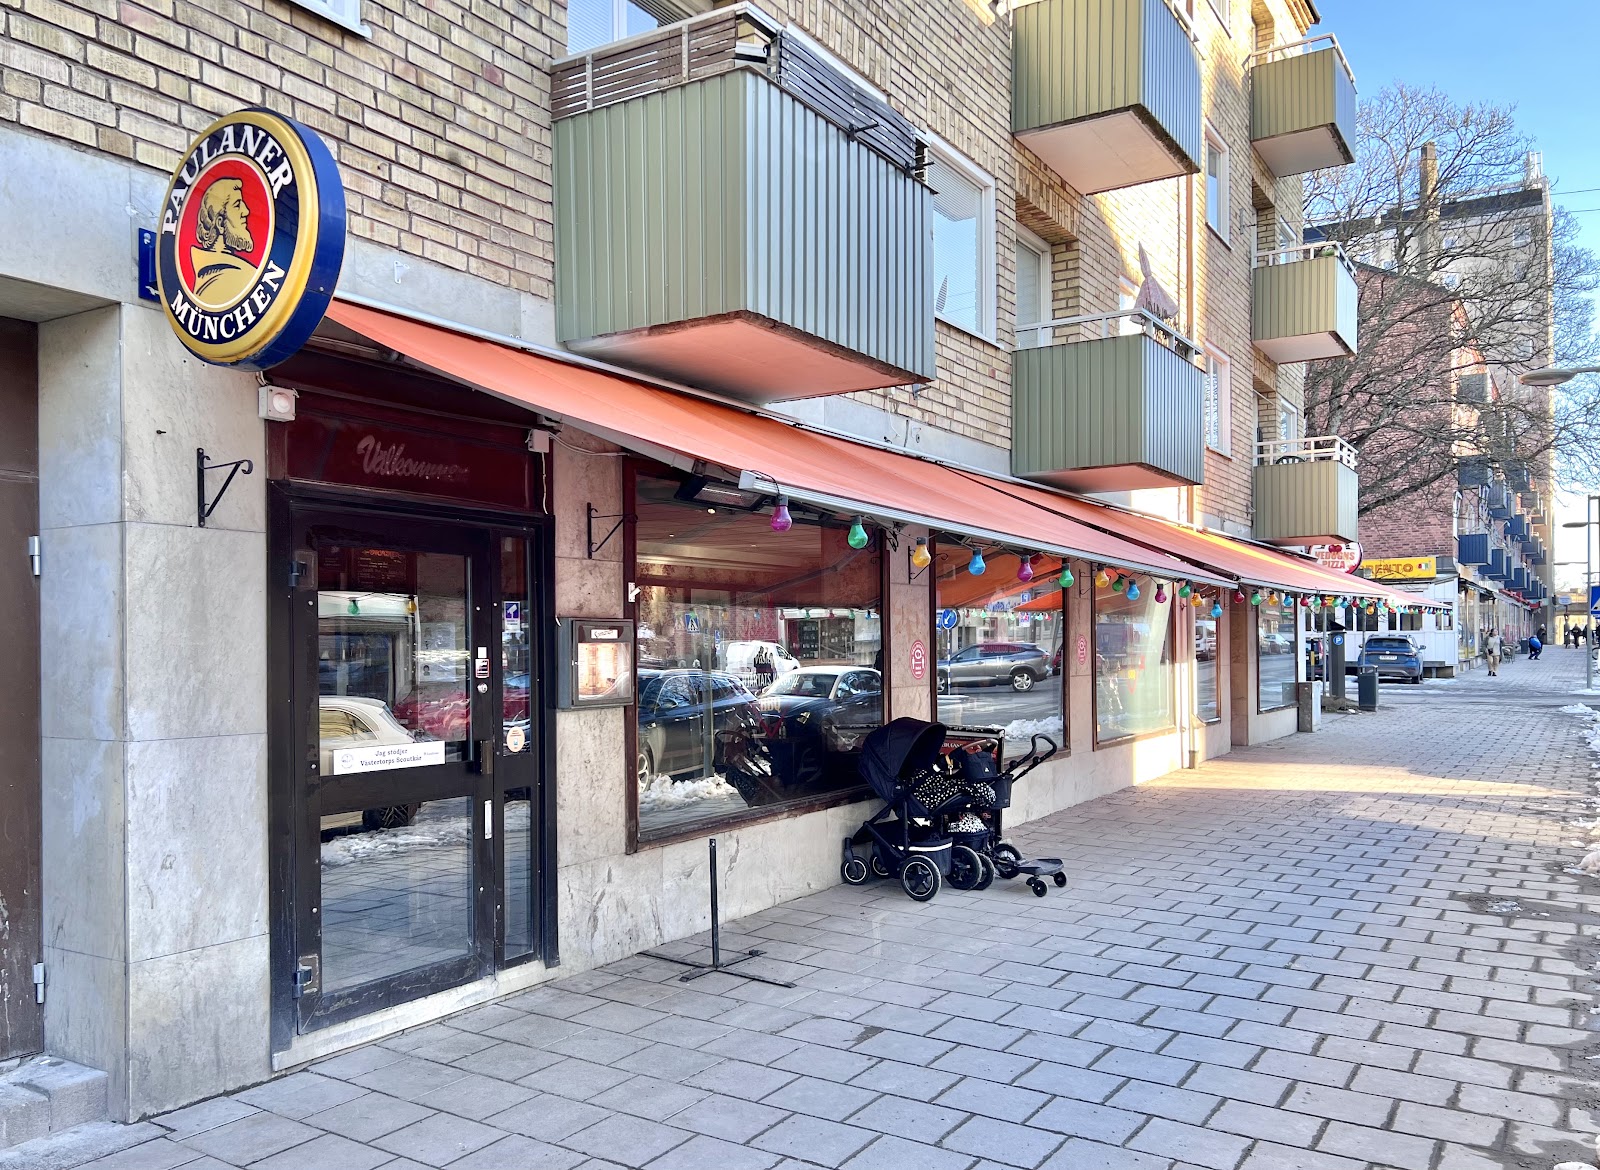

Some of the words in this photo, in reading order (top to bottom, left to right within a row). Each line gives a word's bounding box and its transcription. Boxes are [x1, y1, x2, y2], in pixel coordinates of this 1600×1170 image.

[162, 125, 293, 235] PAULANER
[171, 260, 286, 340] MÜNCHEN
[1322, 560, 1345, 569] PIZZA
